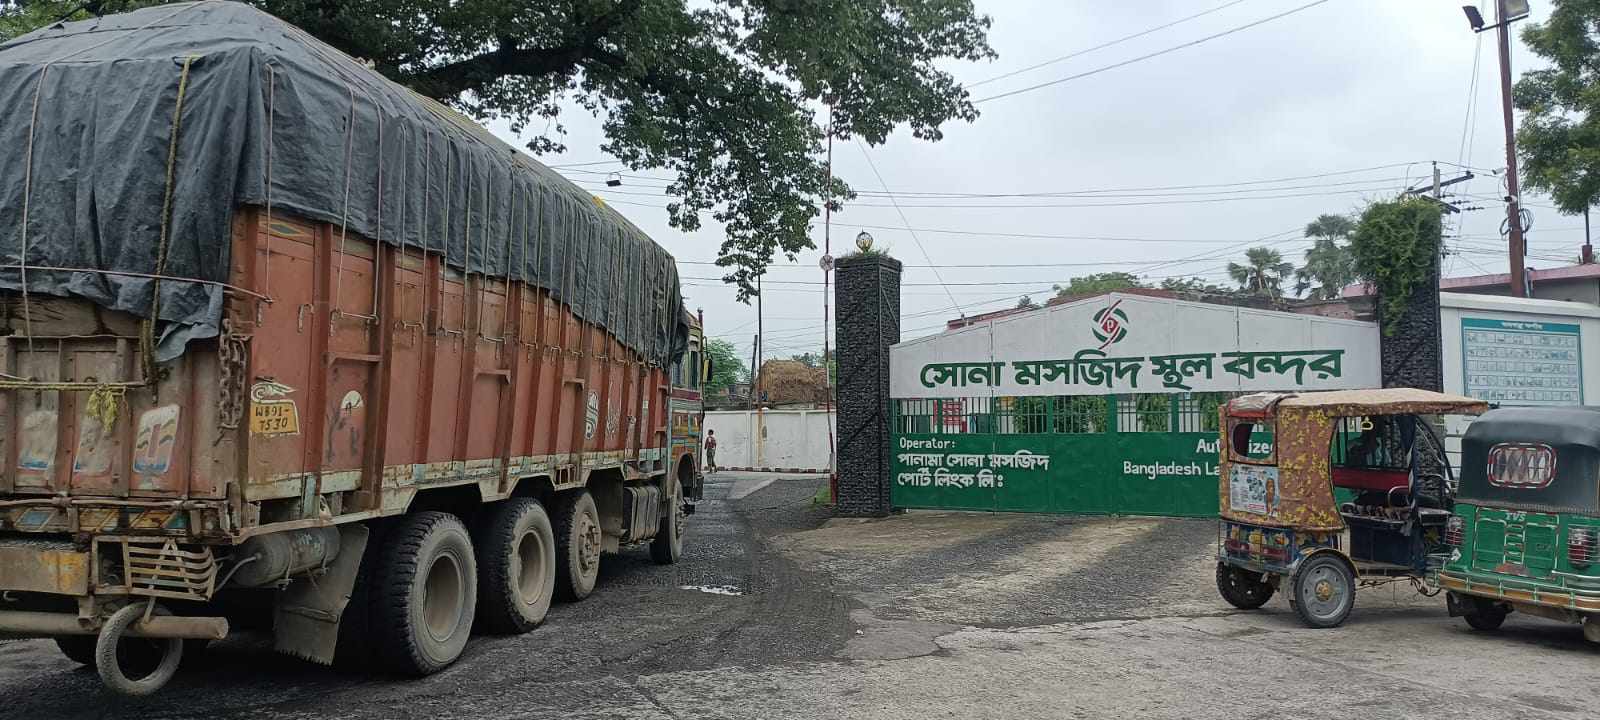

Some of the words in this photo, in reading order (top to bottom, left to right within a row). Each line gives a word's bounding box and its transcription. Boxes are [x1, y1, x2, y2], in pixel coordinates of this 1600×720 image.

[920, 361, 1006, 389] সোনা
[1012, 348, 1145, 389] মসজিদ
[1221, 349, 1345, 385] বন্দর
[259, 417, 288, 431] 7530
[900, 437, 956, 450] Operator:
[1196, 439, 1273, 453] Autize
[897, 453, 945, 467] পানামা
[946, 454, 985, 468] সোনা
[988, 449, 1050, 470] মসজিদ
[897, 467, 932, 486] পোর্ট
[934, 467, 976, 489] লিংক
[1123, 461, 1201, 479] Bangladesh
